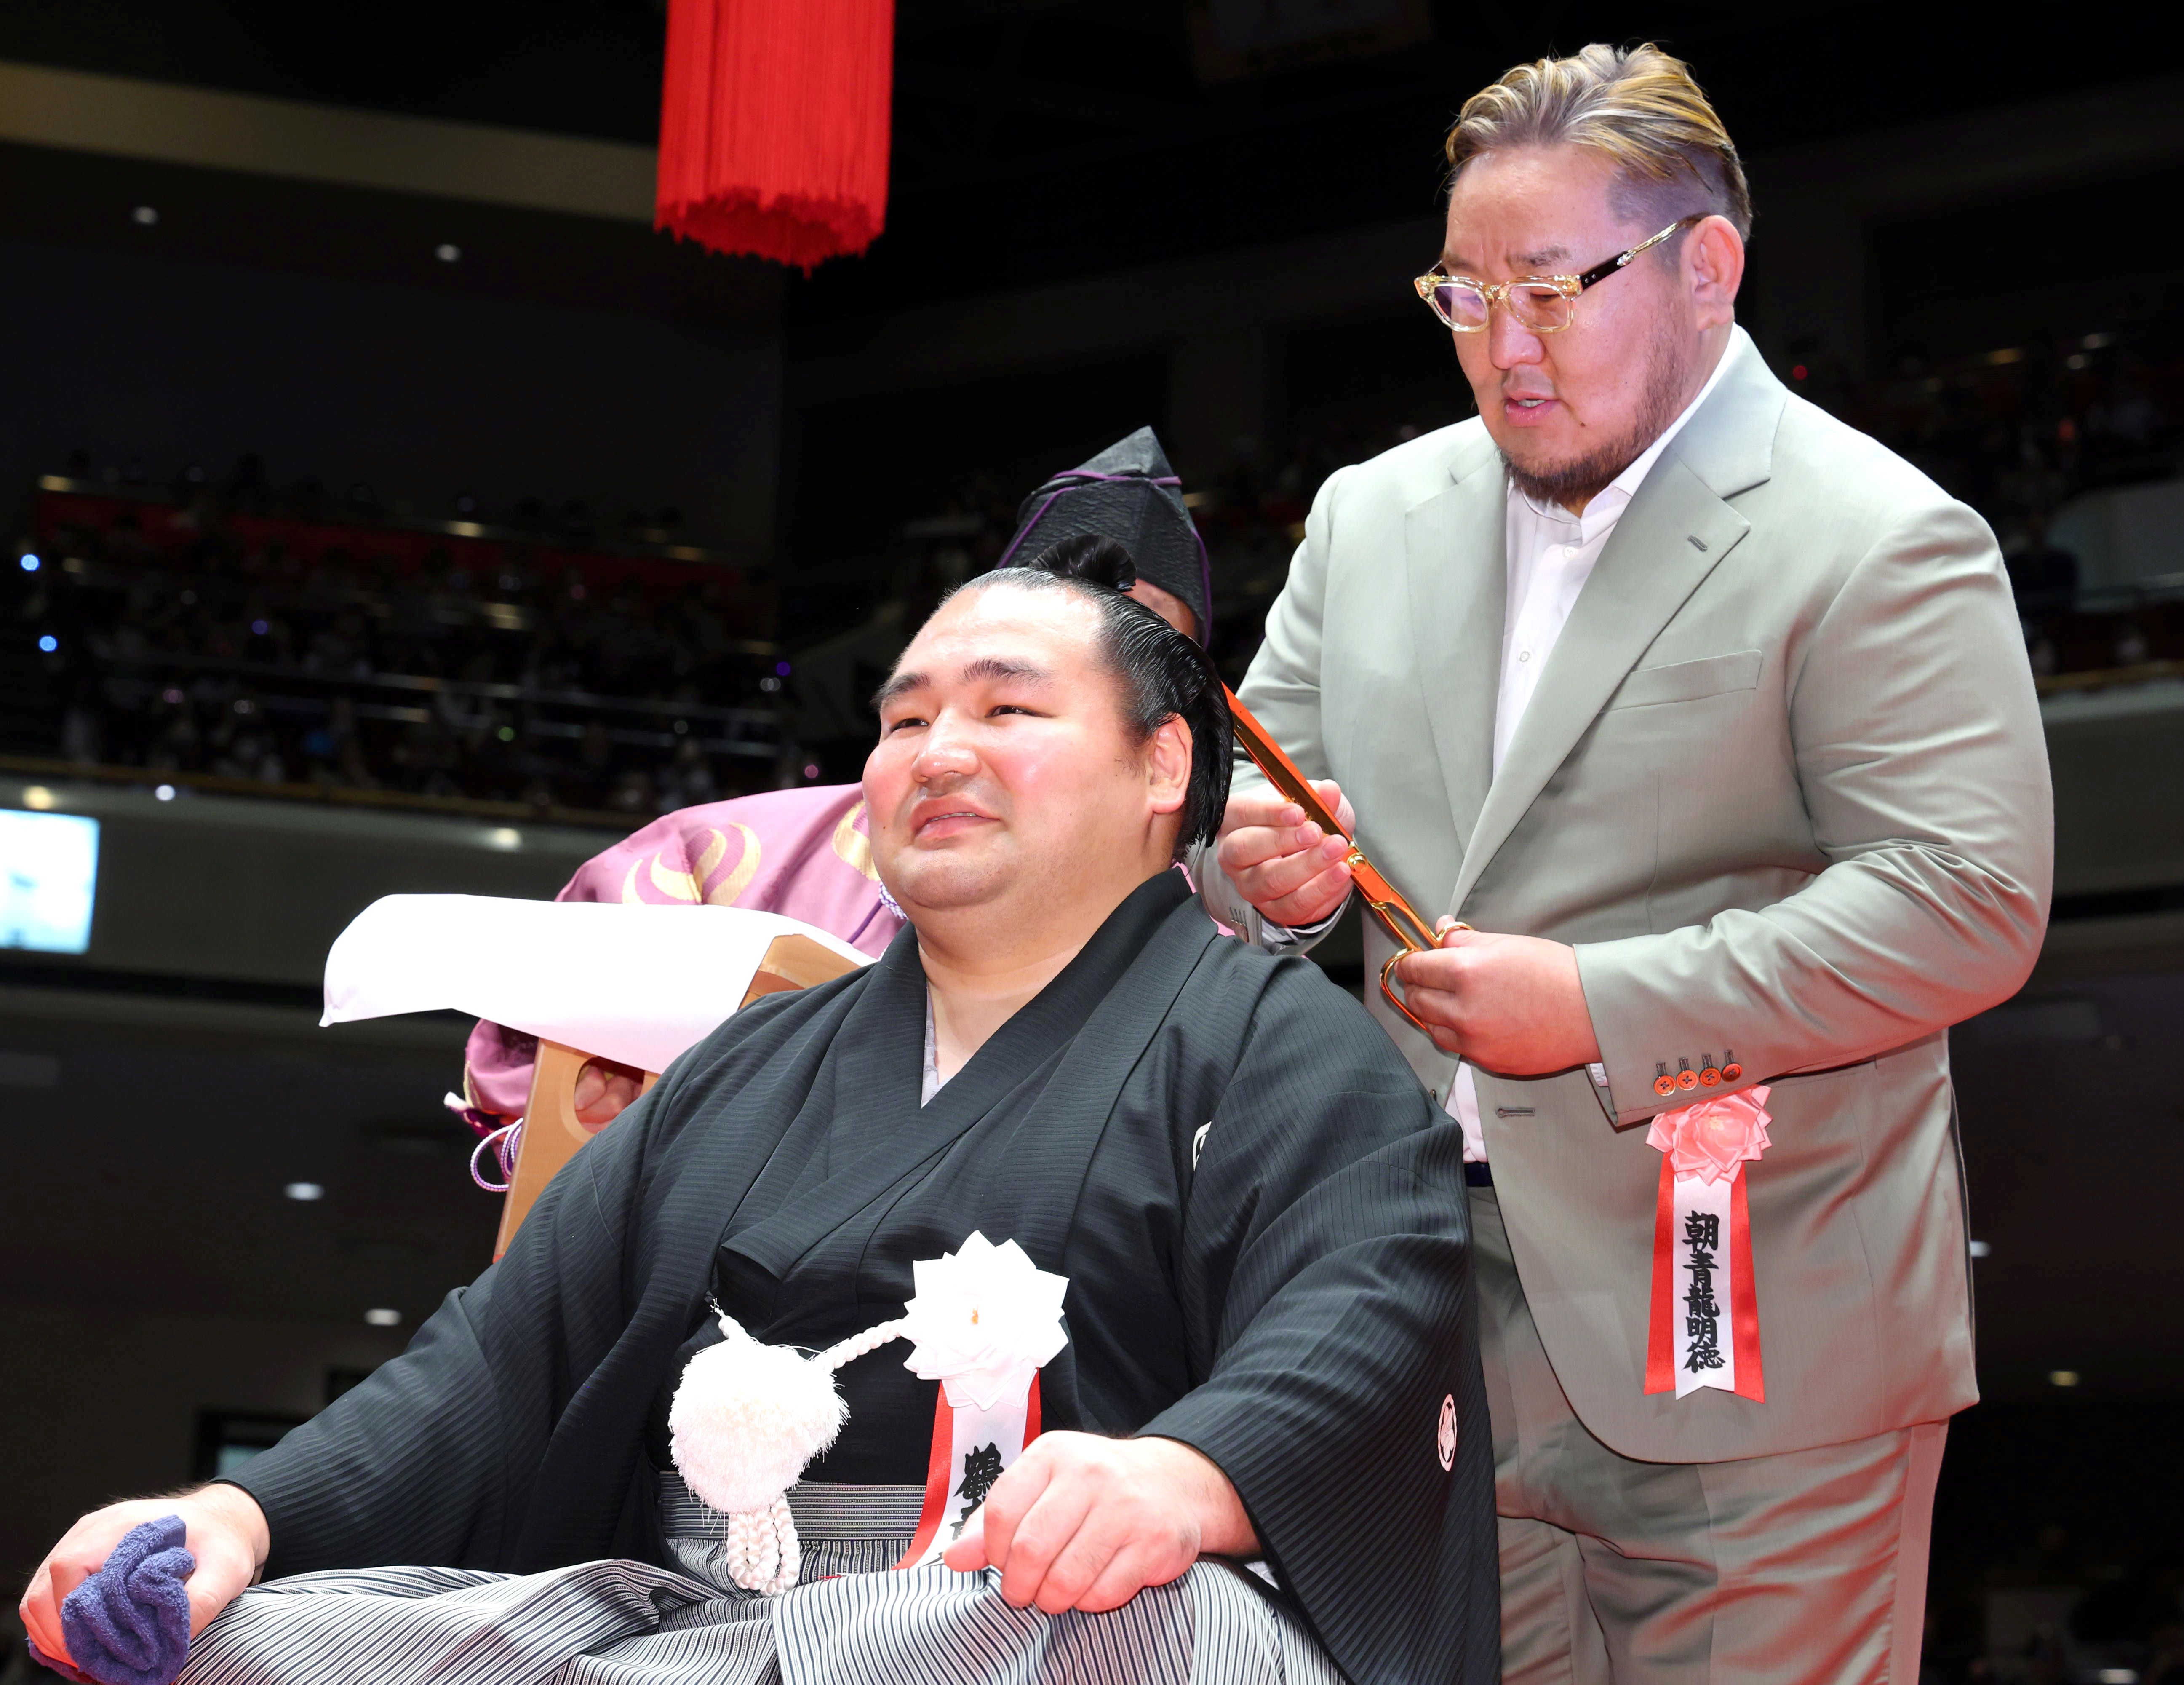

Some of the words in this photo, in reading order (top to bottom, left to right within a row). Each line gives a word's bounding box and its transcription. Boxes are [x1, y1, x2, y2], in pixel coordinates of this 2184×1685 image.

[1682, 1210, 1725, 1373] 朝青龍明徳
